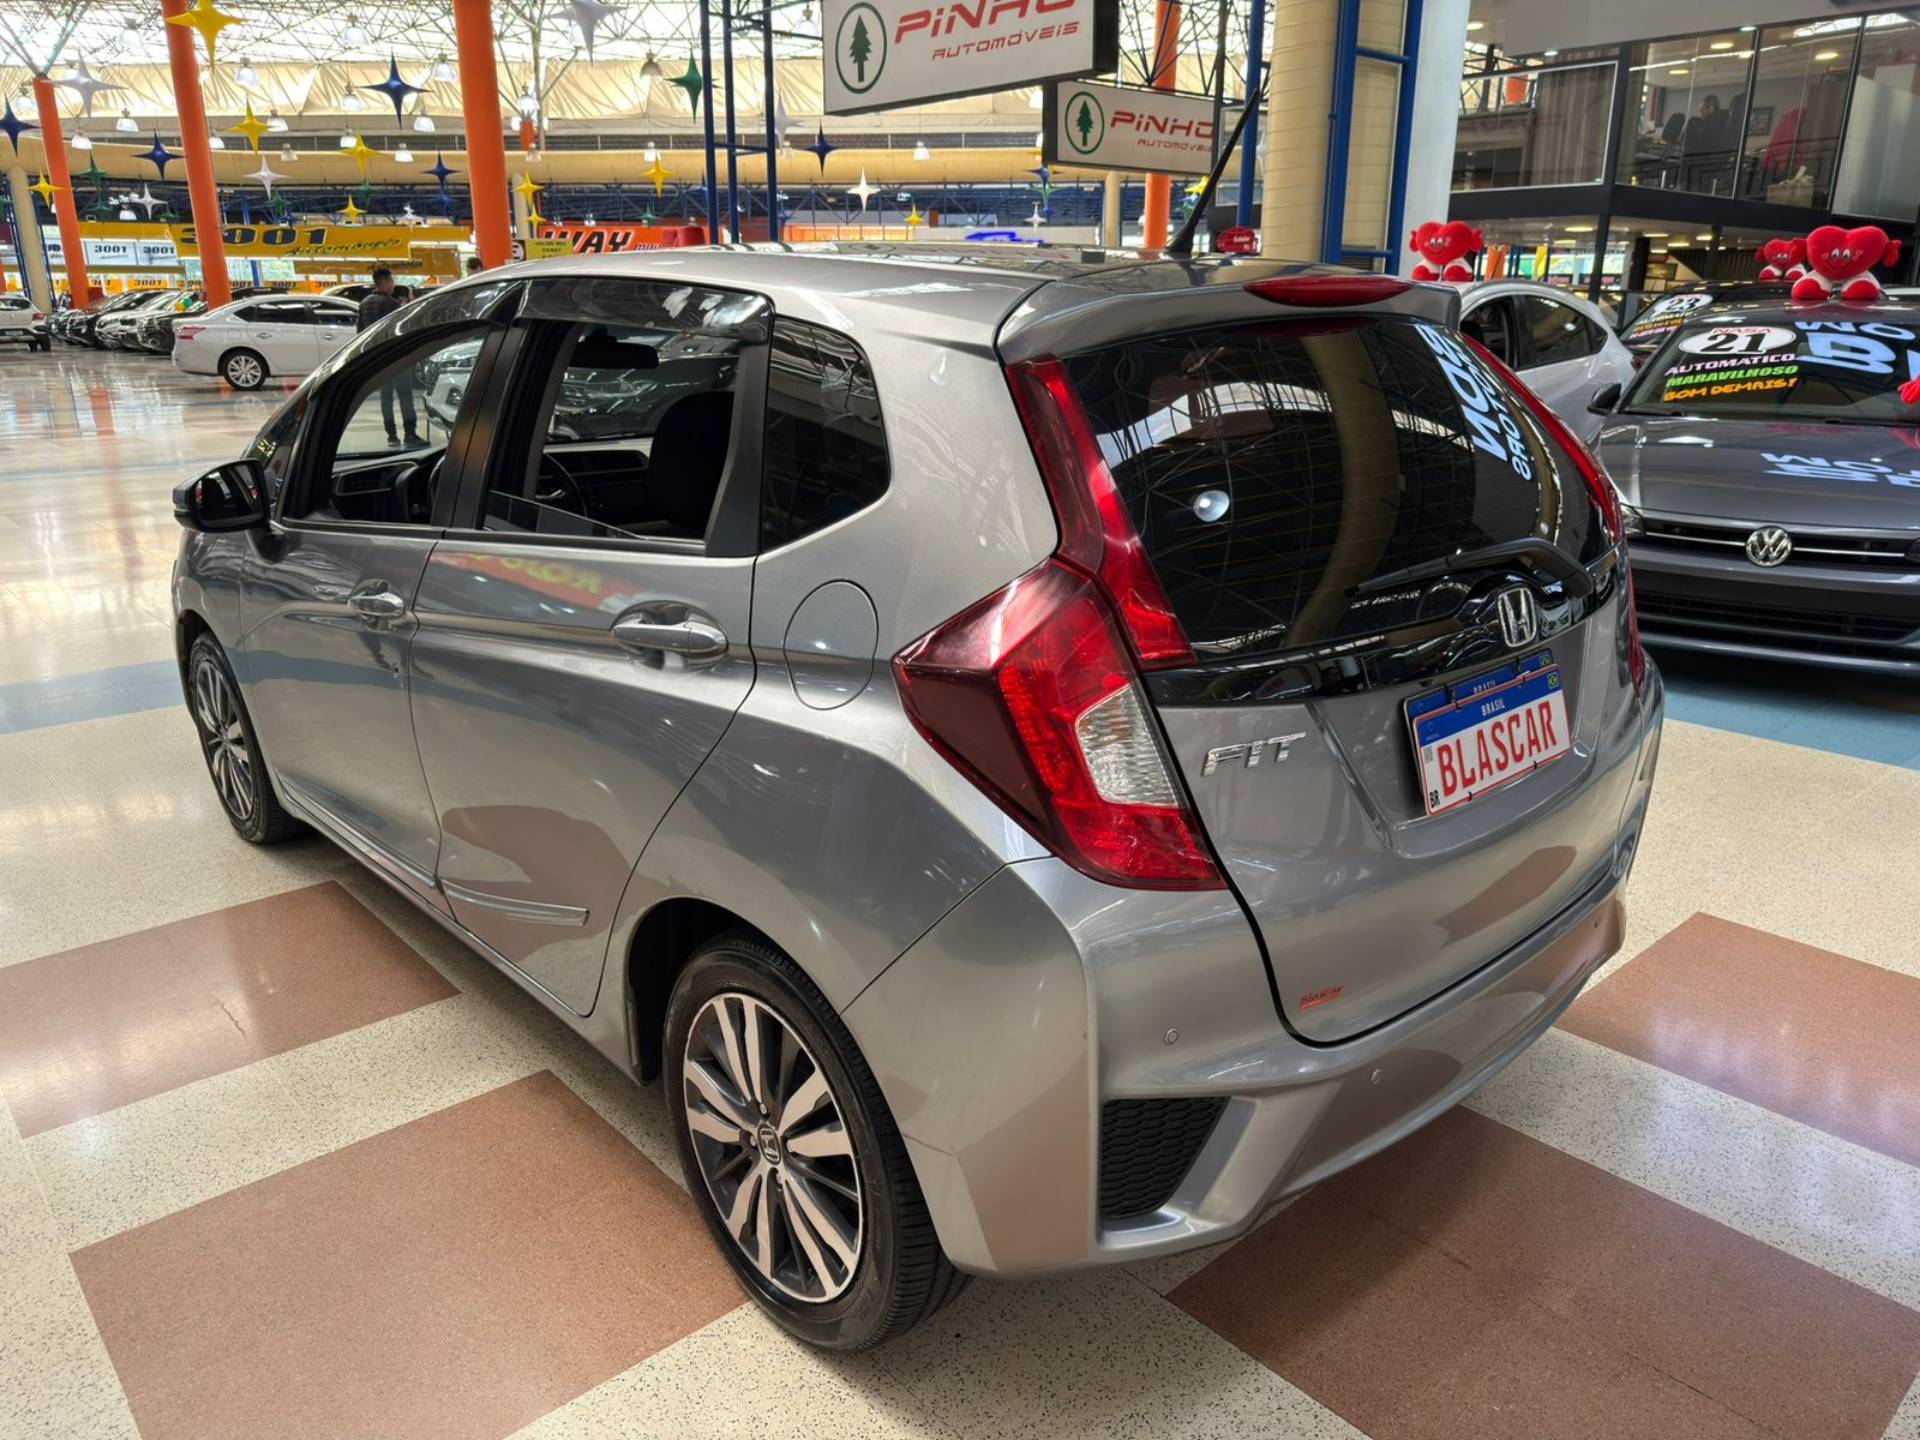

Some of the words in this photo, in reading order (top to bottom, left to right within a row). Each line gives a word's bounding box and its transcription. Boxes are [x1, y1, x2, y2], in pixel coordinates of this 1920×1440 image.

[94, 244, 127, 254] 3001
[143, 246, 175, 255] 3001
[1700, 333, 1767, 352] 21
[1665, 365, 1799, 388] MARAVILHOSO
[1480, 699, 1506, 717] BRASIL
[1202, 732, 1307, 777] FIT
[1436, 700, 1558, 797] BLASCAR
